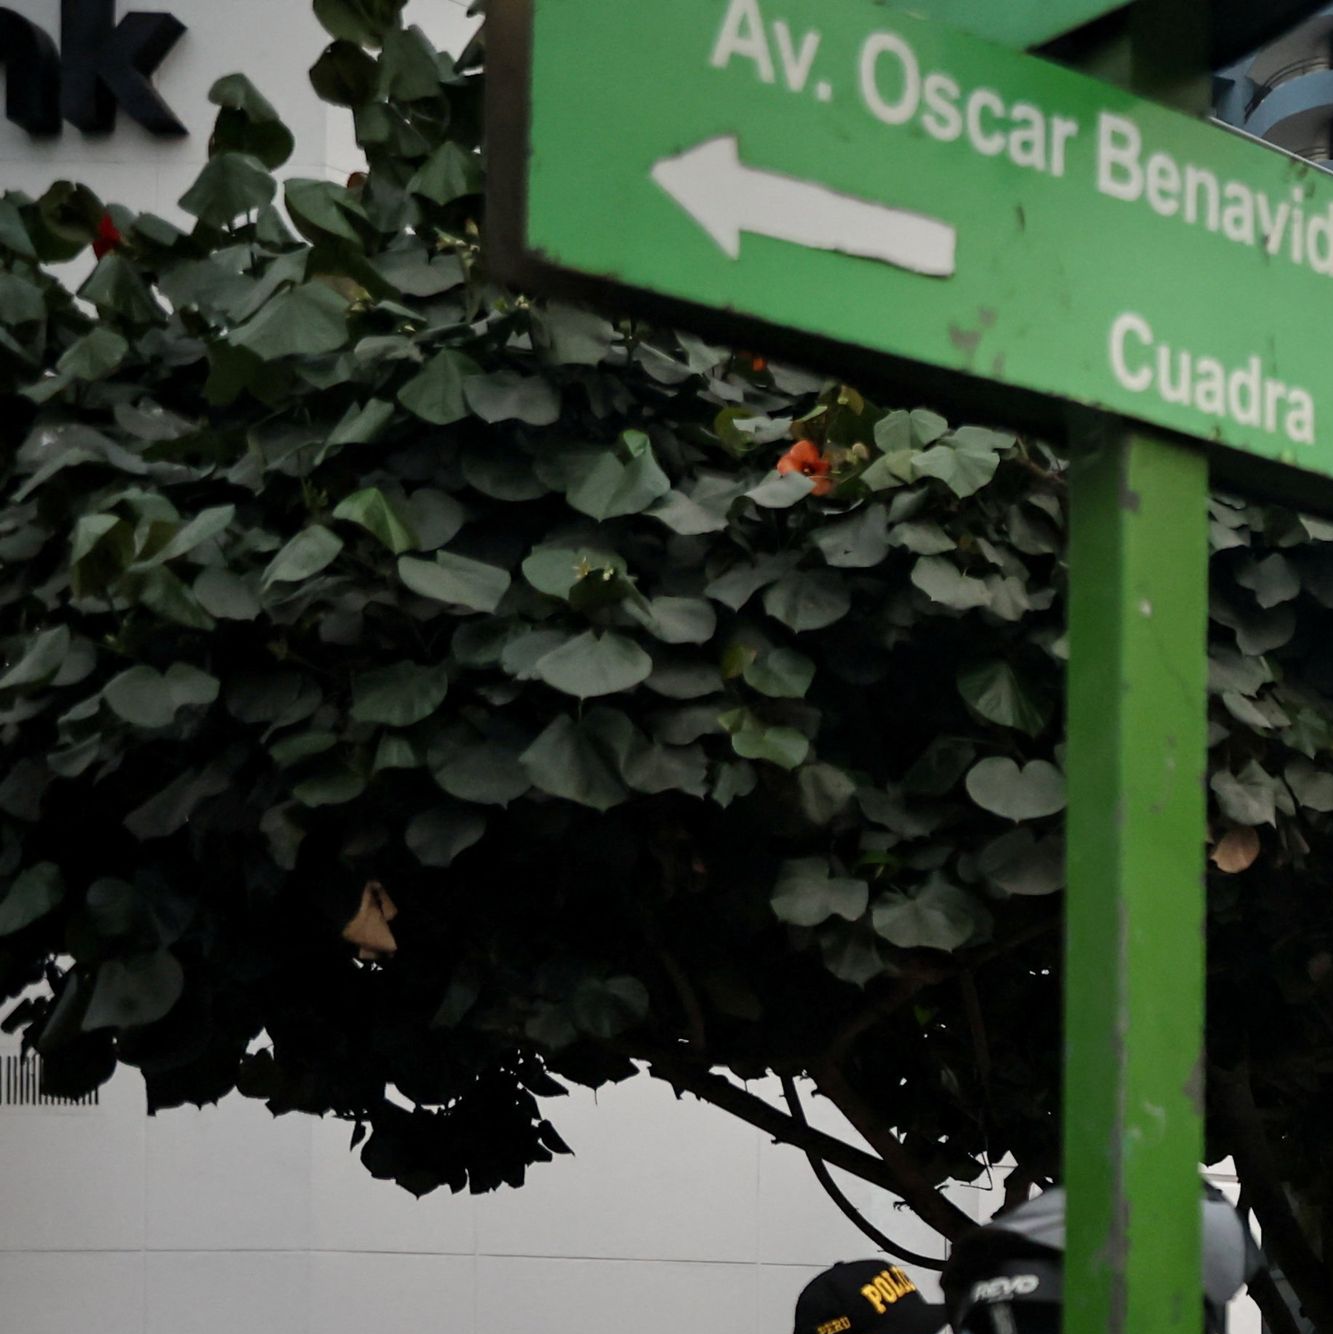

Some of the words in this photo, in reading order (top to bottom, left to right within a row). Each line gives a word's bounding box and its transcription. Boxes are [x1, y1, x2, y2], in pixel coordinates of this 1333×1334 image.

[711, 0, 832, 102] Av.
[860, 31, 1079, 177] Oscar
[1109, 312, 1315, 446] Cuadra
